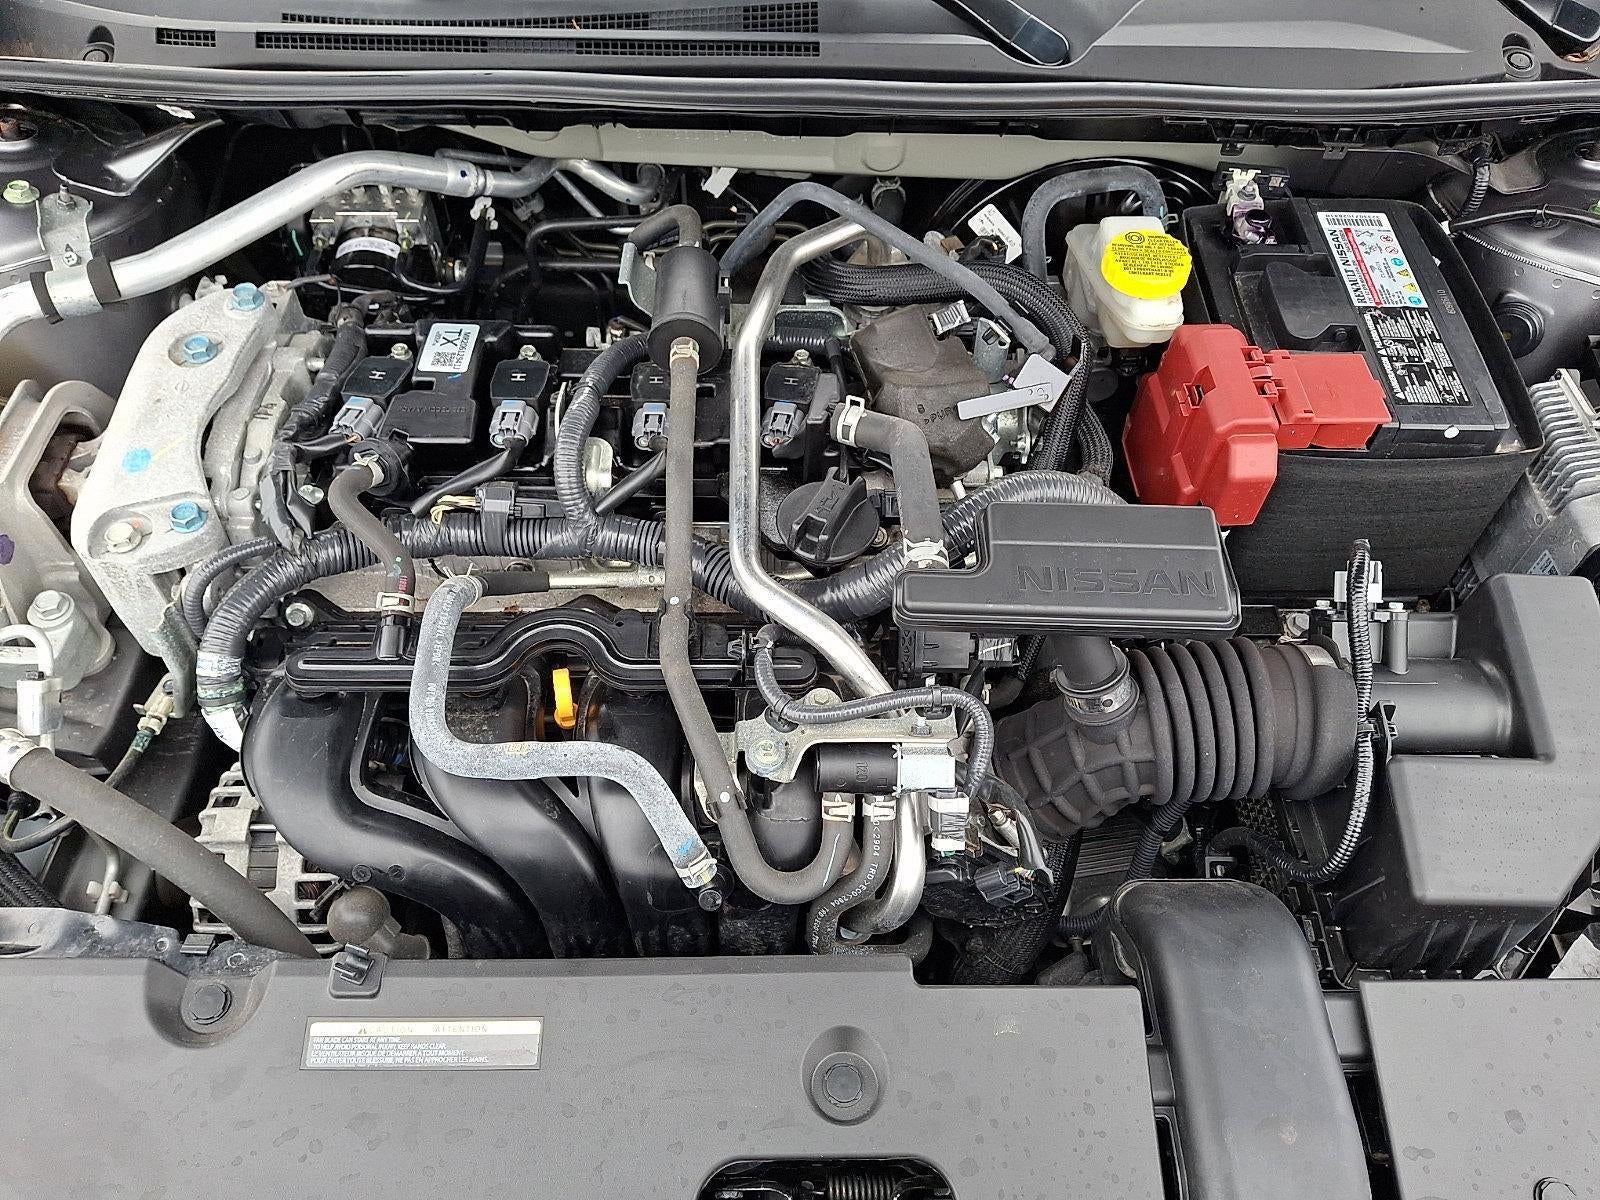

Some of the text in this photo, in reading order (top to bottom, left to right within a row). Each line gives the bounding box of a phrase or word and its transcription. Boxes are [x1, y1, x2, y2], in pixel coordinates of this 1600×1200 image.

[1328, 229, 1351, 267] NISSAN
[1344, 268, 1367, 304] RENAULT
[440, 328, 463, 346] TX
[1017, 565, 1217, 597] NISSAN
